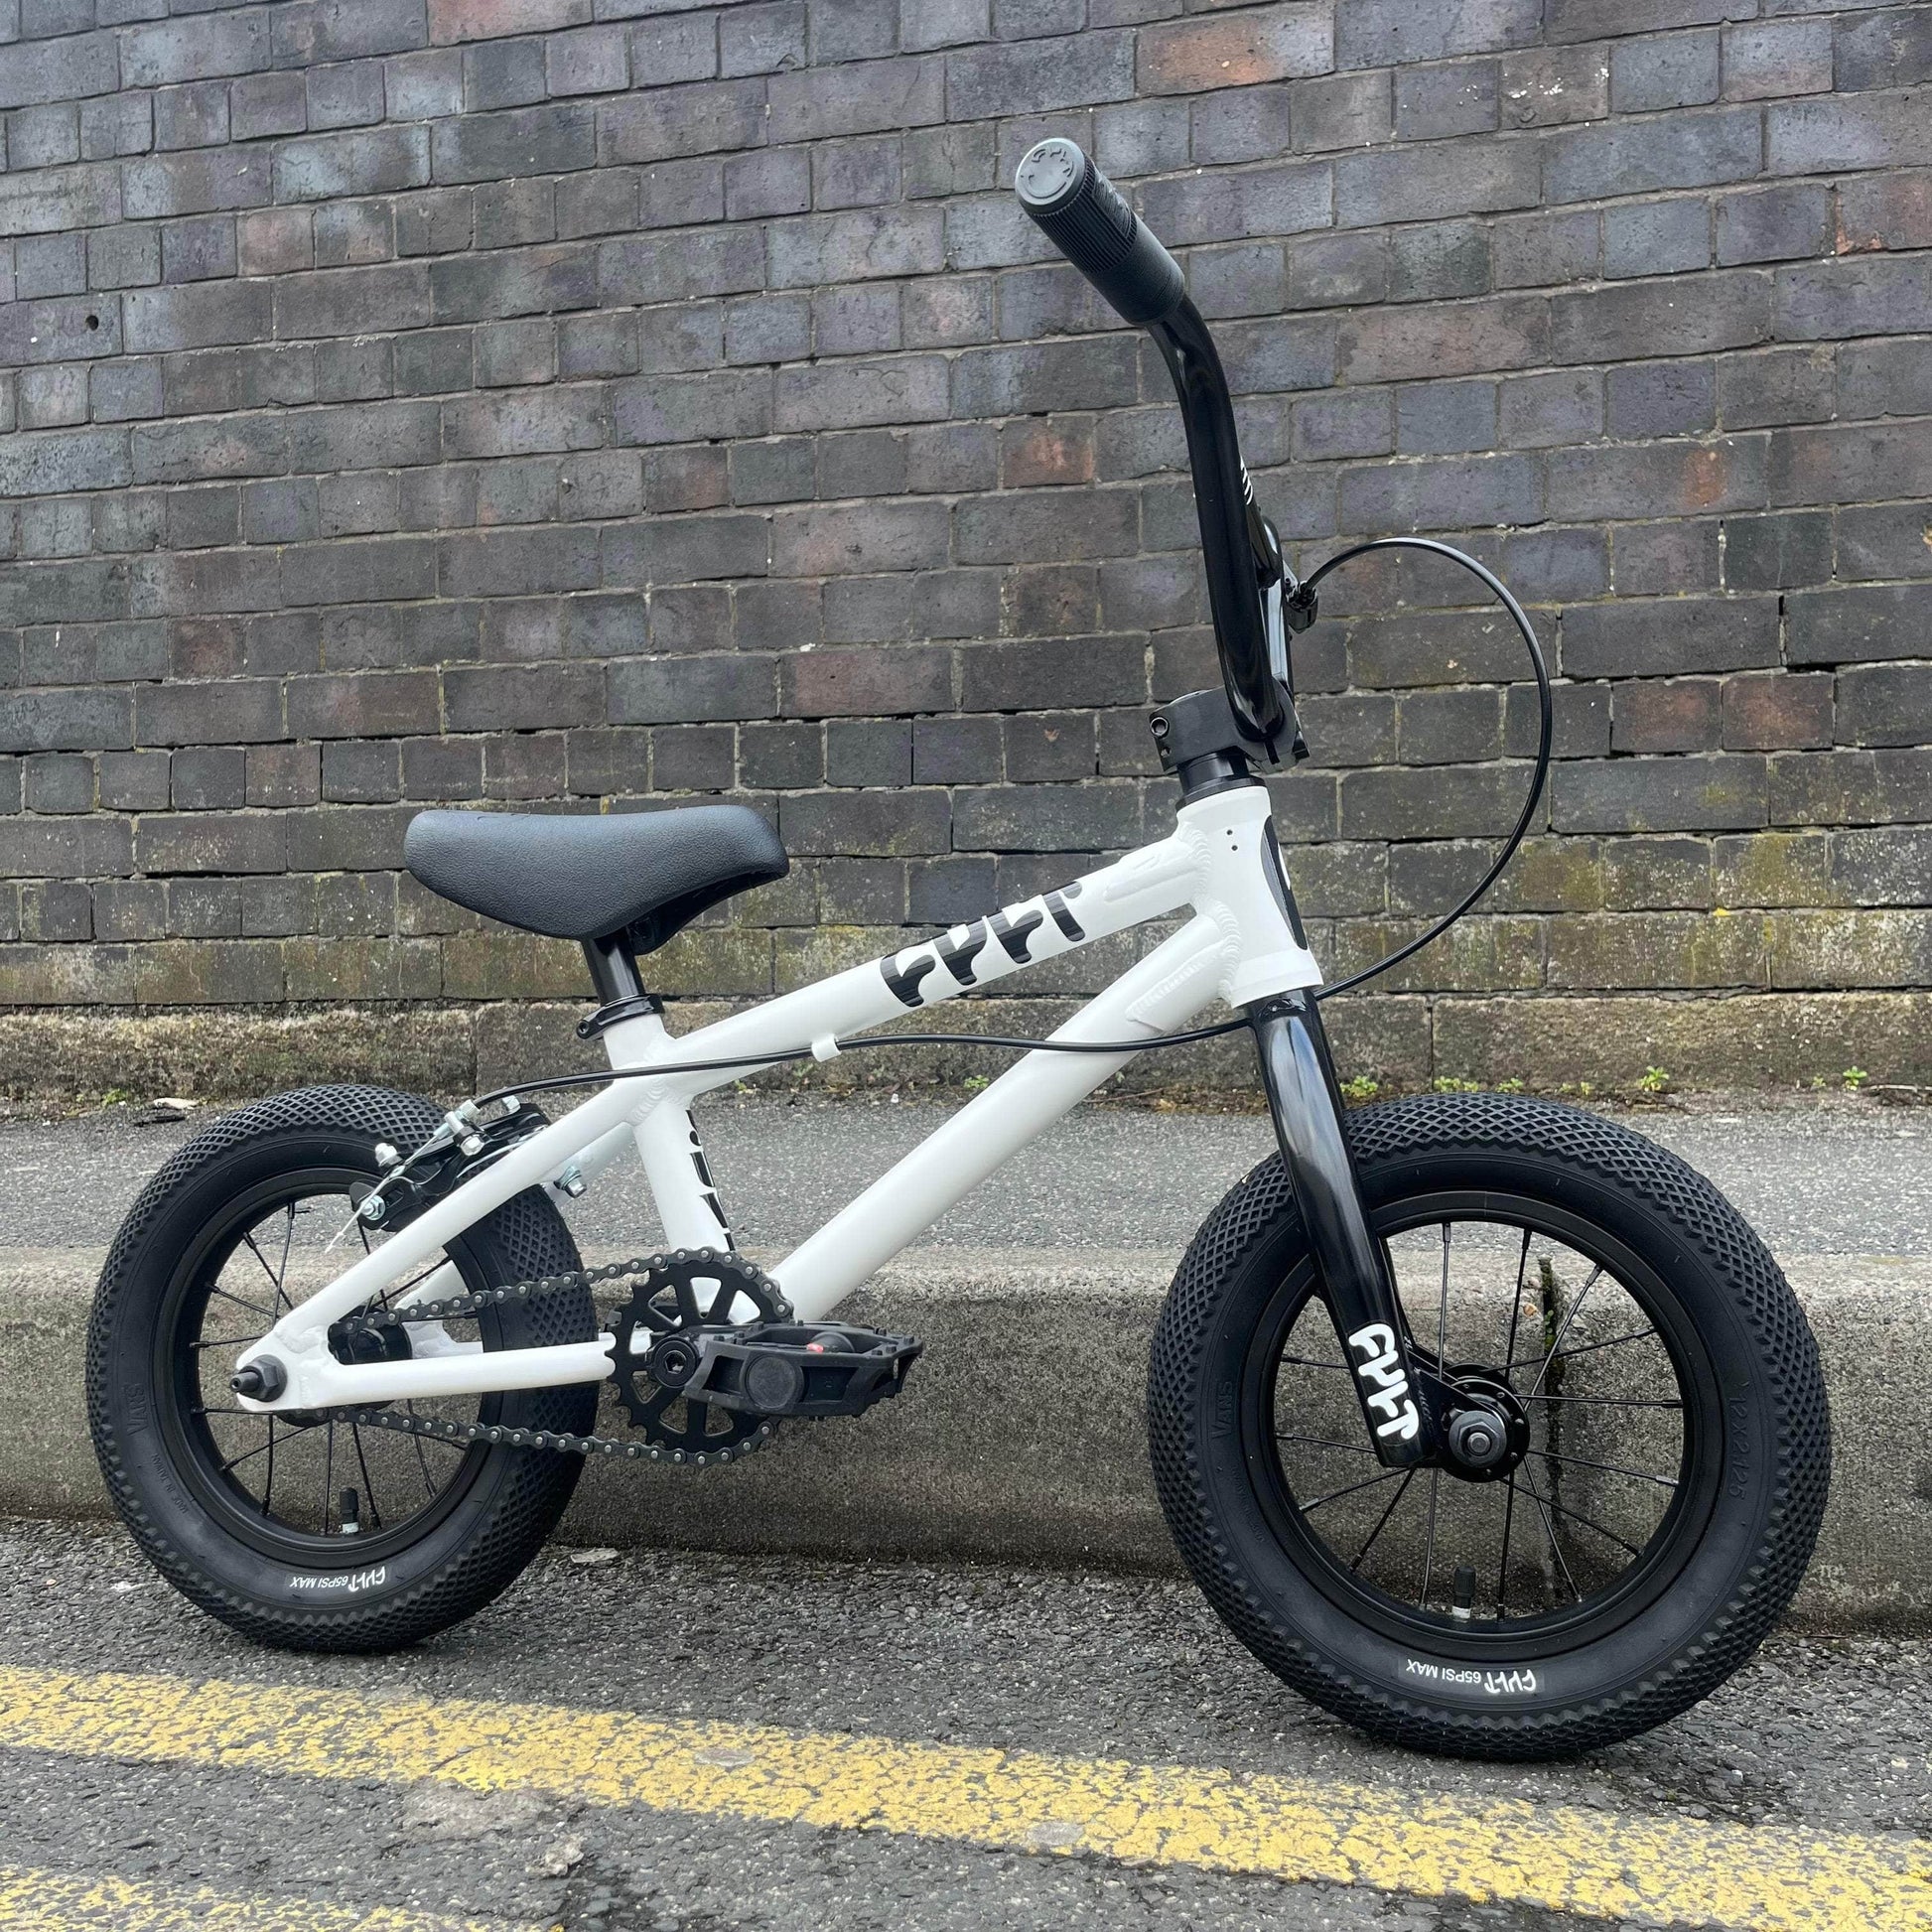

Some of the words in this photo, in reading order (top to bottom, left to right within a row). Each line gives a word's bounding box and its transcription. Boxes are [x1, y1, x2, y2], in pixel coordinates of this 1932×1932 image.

[1348, 1322, 1419, 1440] CULT
[289, 1576, 317, 1588] MAX
[317, 1576, 348, 1588] 65PSI
[347, 1566, 386, 1592] CULT
[1406, 1658, 1438, 1679] MAX
[1442, 1667, 1482, 1684] 65PSI
[1484, 1669, 1537, 1694] CULT
